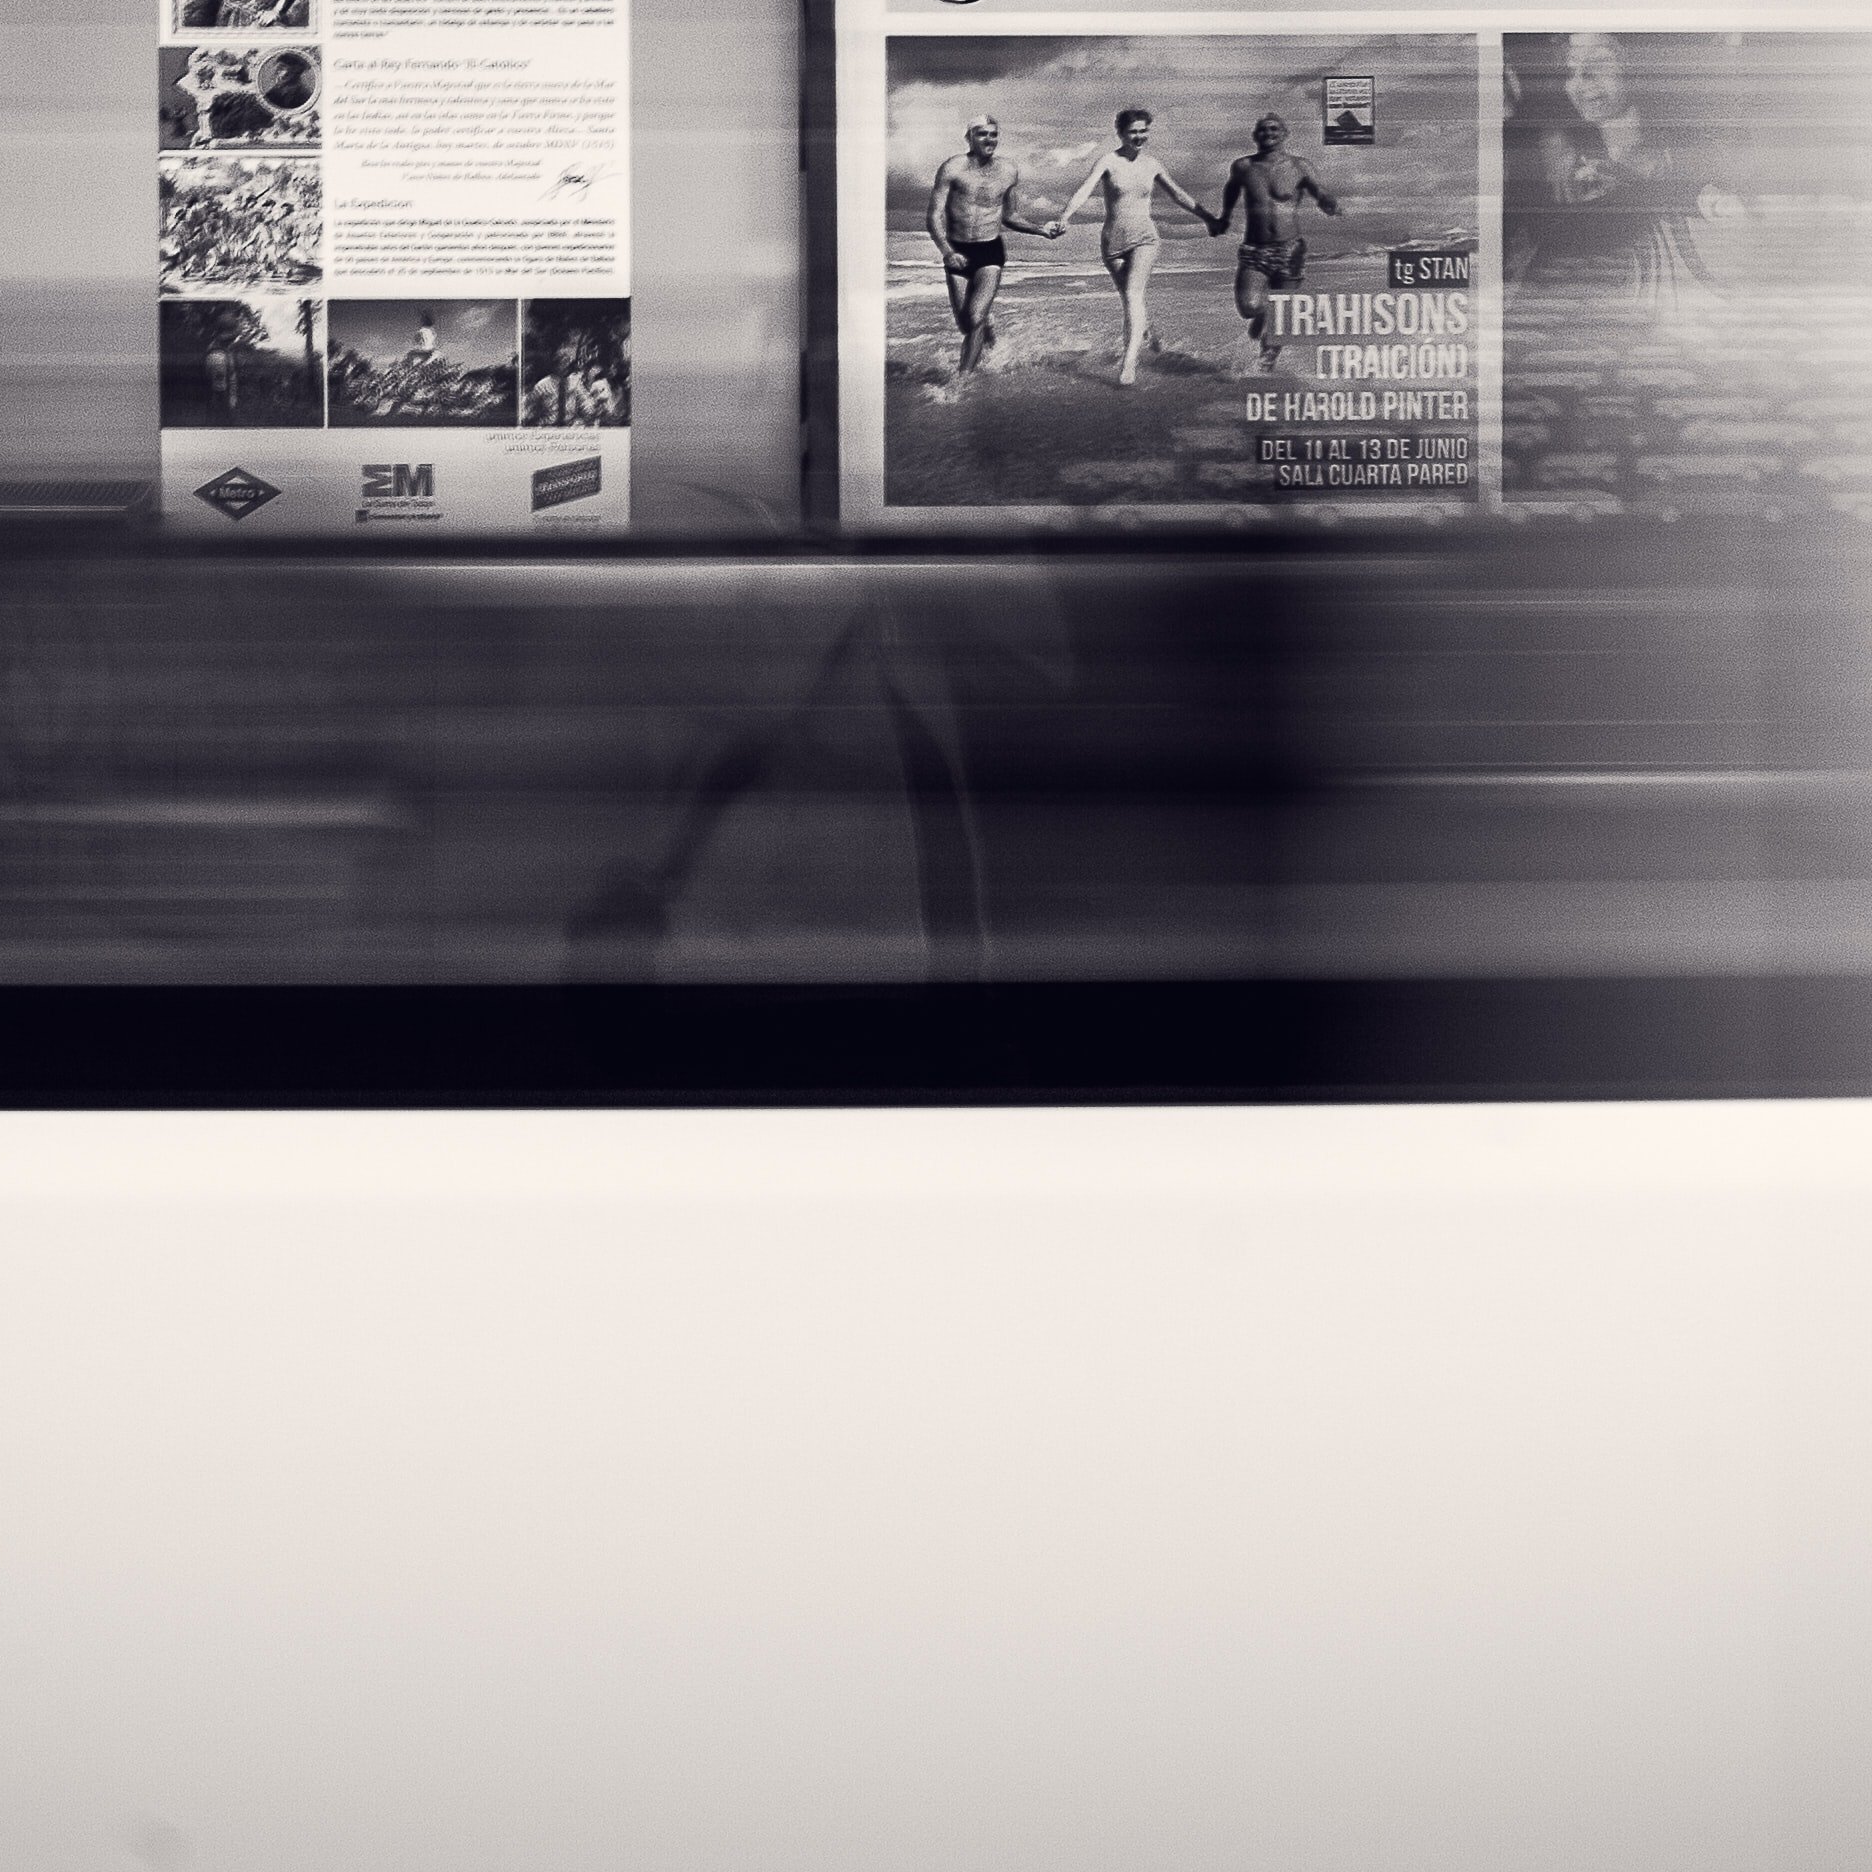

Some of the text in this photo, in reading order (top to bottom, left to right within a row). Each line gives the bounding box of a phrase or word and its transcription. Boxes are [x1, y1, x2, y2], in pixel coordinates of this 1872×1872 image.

[1394, 256, 1470, 285] tg STAN
[1268, 293, 1468, 337] TRAHISONS
[1245, 390, 1469, 422] DE HAROLD PINTER
[1261, 439, 1297, 461] DEL
[1329, 439, 1352, 460] AL
[1359, 438, 1382, 460] 13
[1386, 438, 1411, 460] DE
[1415, 437, 1468, 460] JUNIO
[1279, 463, 1469, 486] SALA CUARTA PARED
[218, 486, 256, 500] Metro
